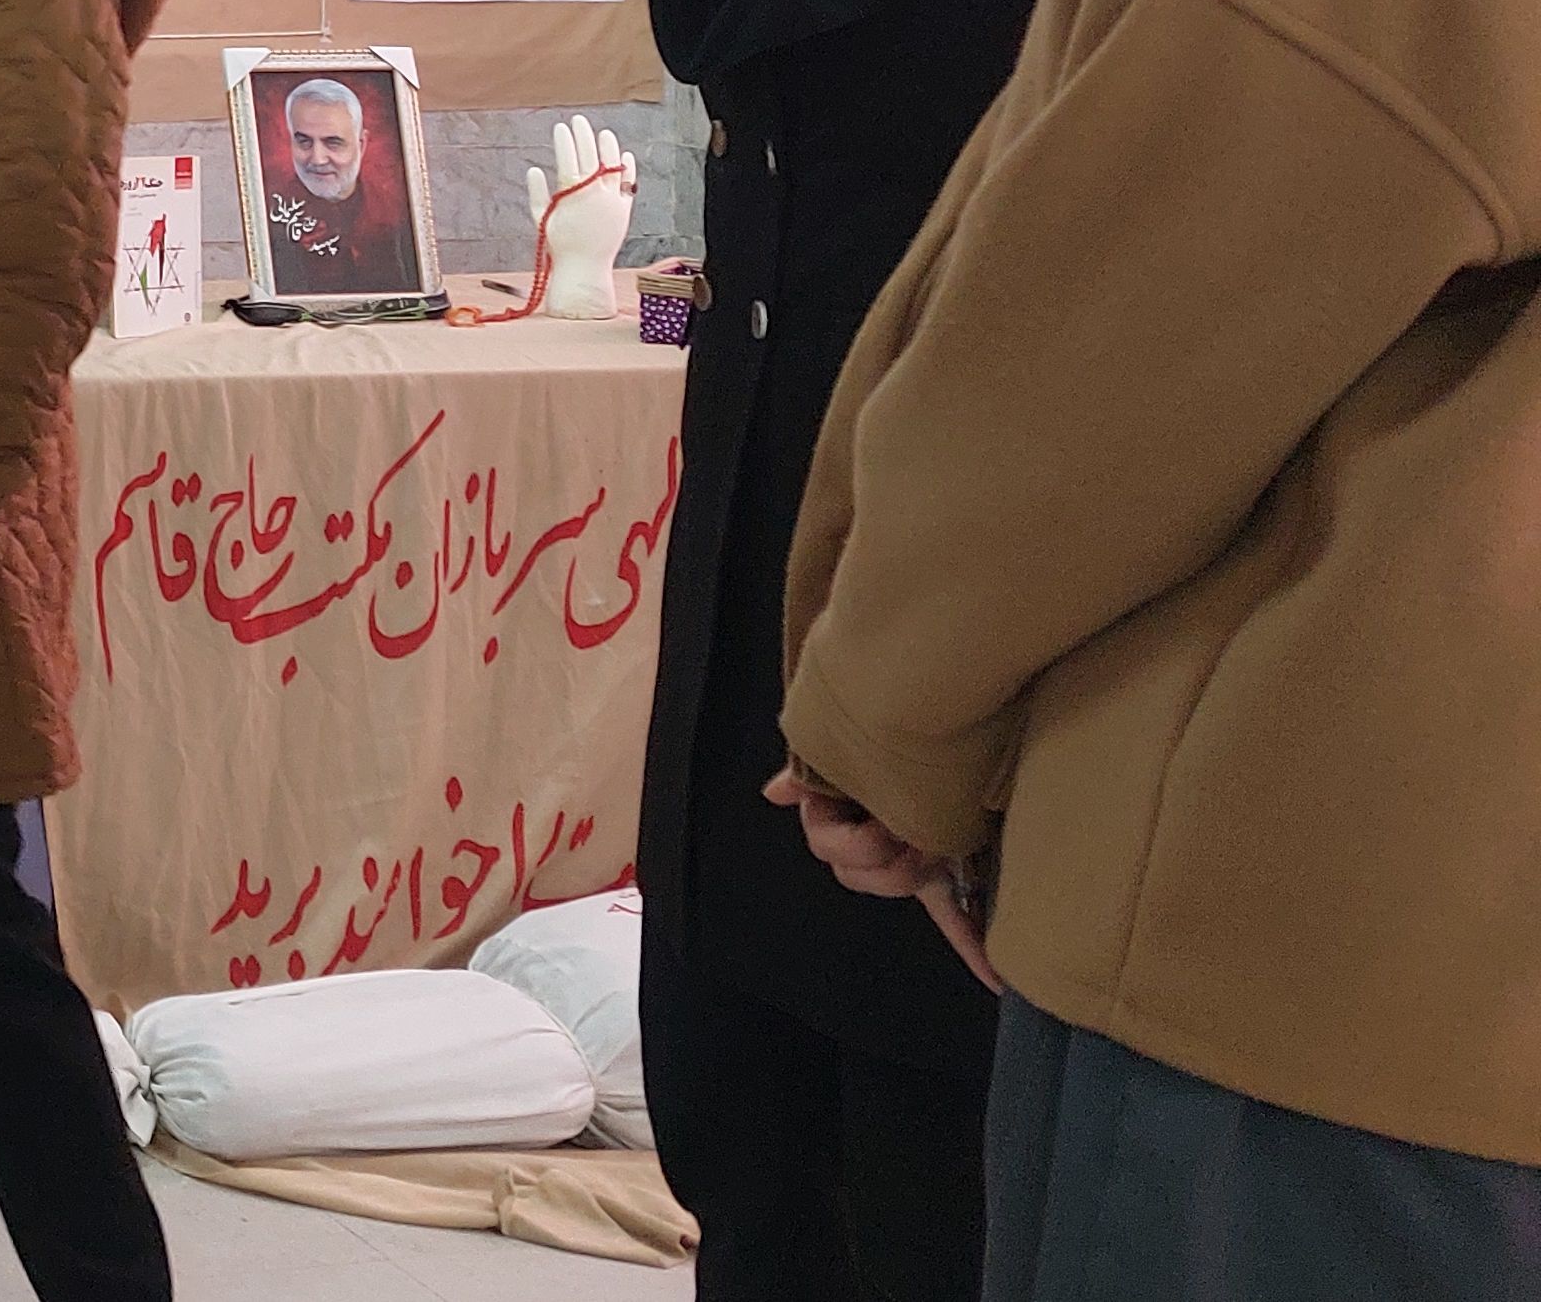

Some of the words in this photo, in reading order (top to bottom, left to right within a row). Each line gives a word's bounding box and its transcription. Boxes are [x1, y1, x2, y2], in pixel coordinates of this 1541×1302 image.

[93, 451, 202, 684] قاسم
[230, 409, 445, 687] مکتب
[565, 436, 681, 650] لهی
